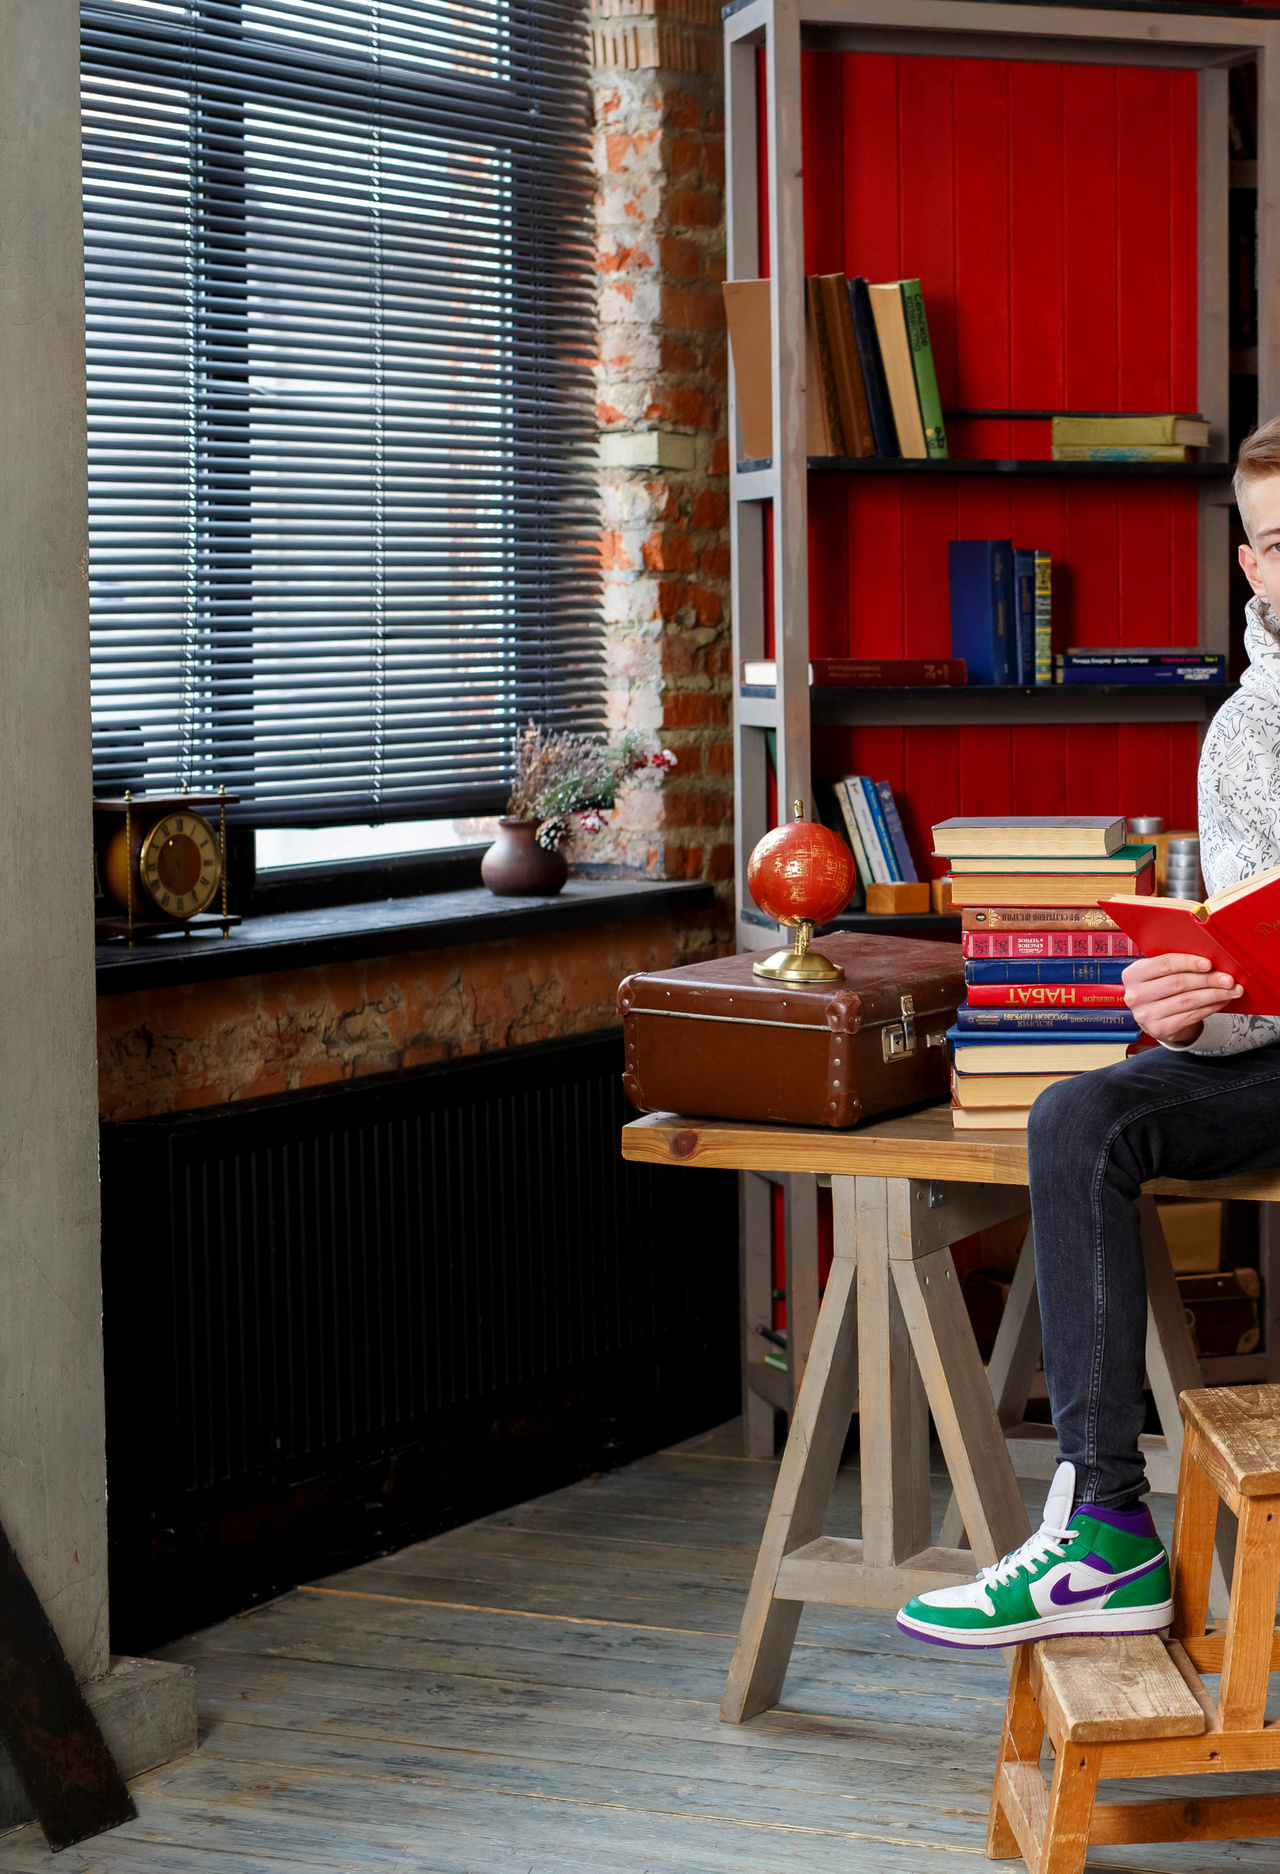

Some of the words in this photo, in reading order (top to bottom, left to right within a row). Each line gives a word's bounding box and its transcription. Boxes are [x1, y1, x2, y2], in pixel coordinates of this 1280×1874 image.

[1005, 987, 1076, 1004] НАБАТ
[1082, 995, 1115, 1003] ШЕВЦОВ
[1003, 1013, 1033, 1022] ЦЕРКВИ
[1034, 1013, 1068, 1021] РУССКОЙ
[1017, 1020, 1054, 1028] ИСТОРИЯ
